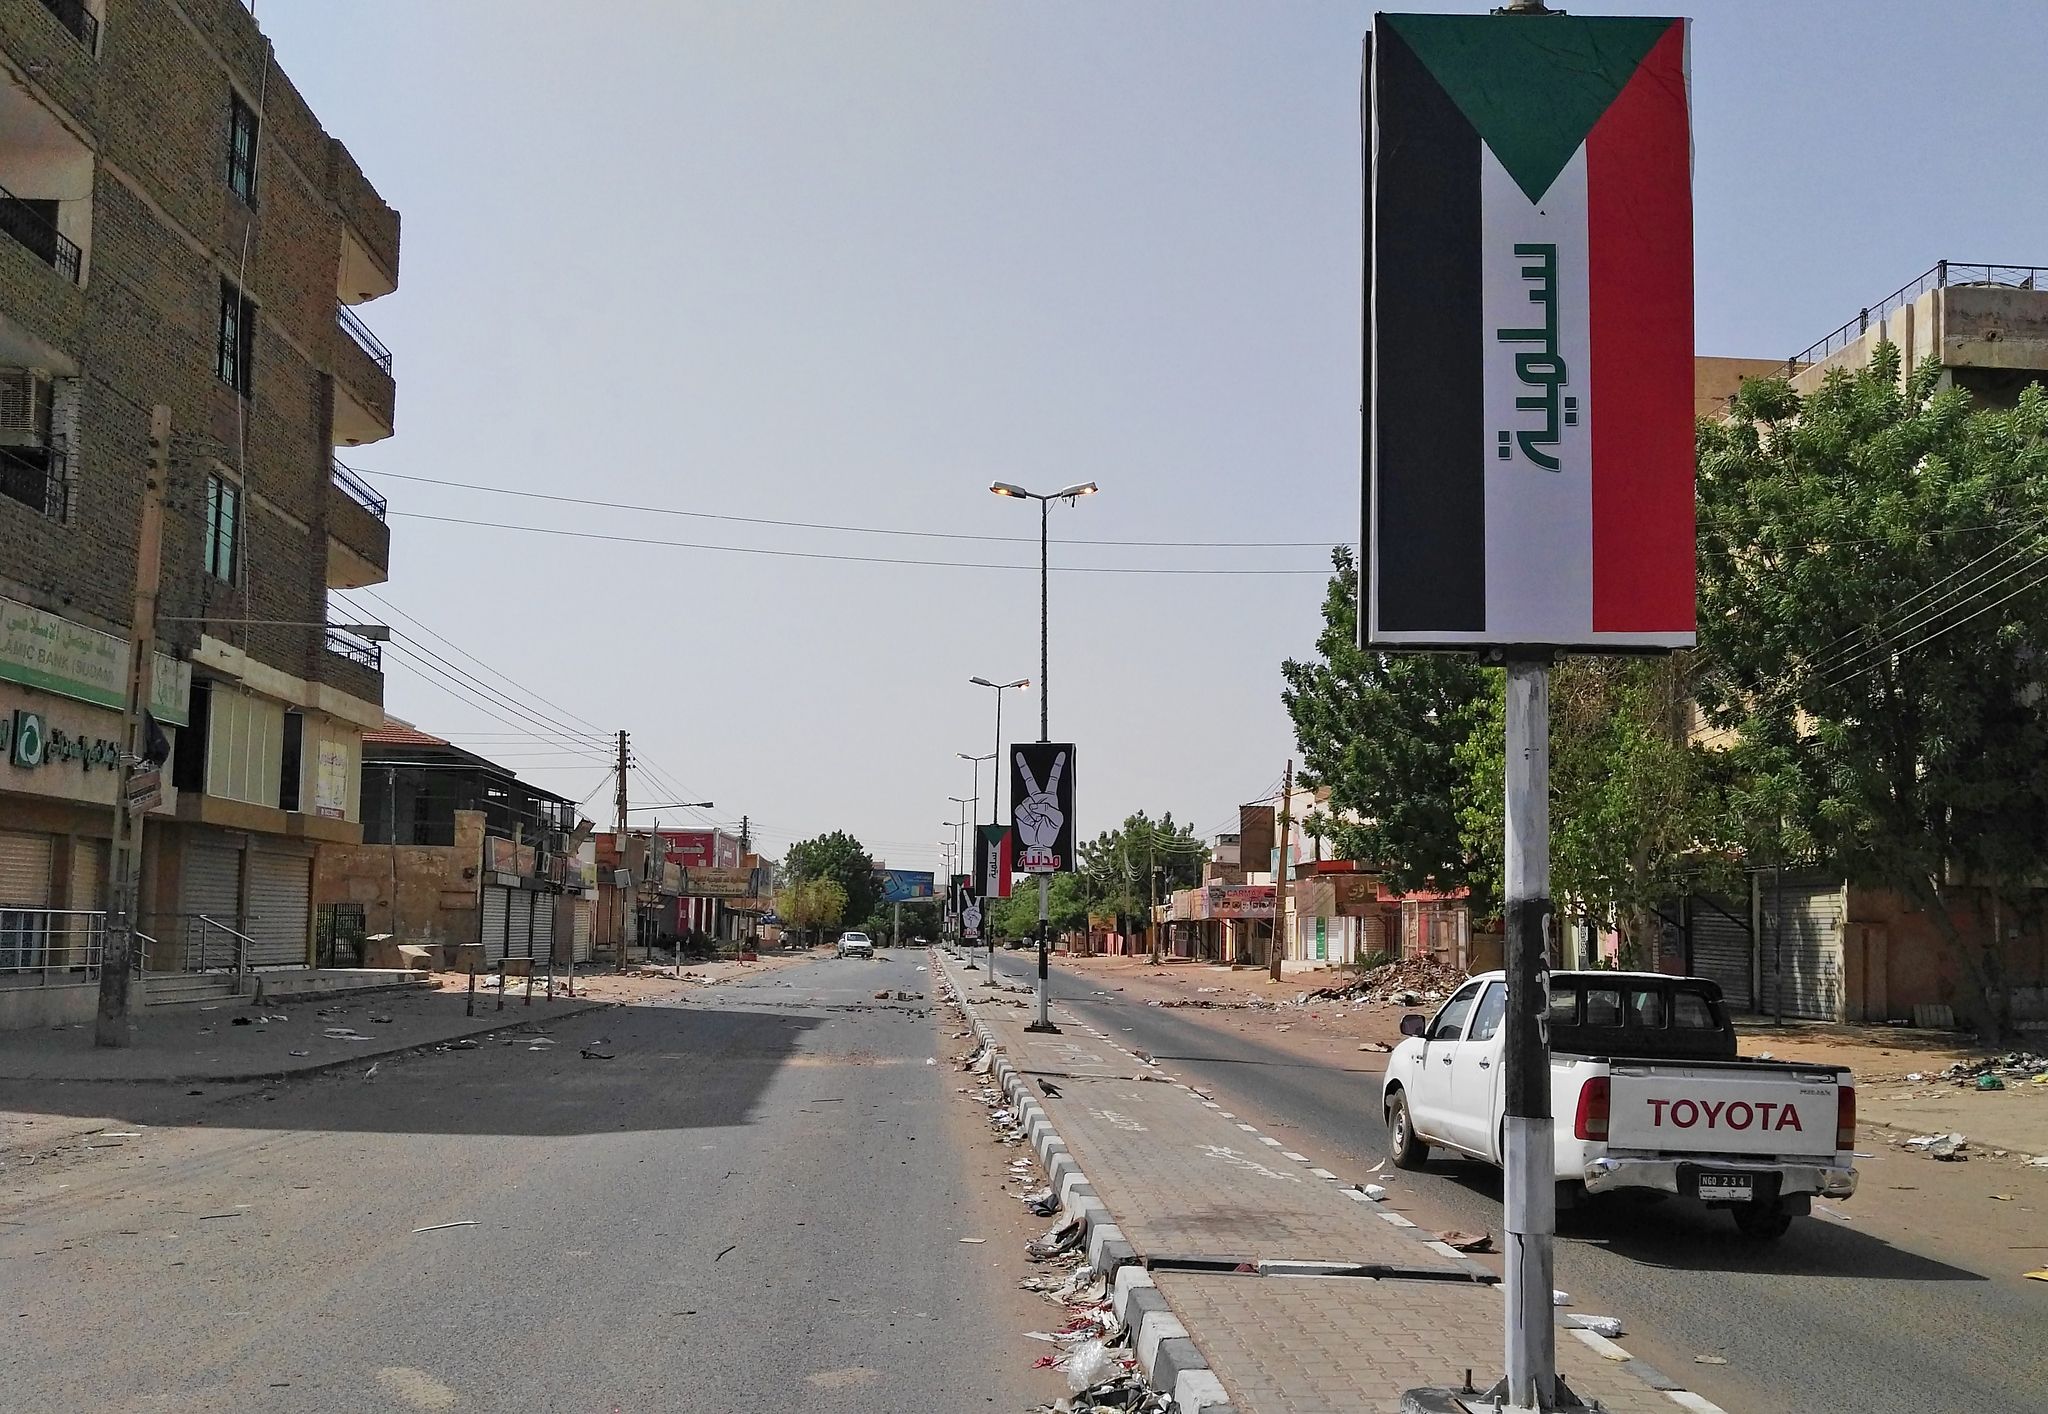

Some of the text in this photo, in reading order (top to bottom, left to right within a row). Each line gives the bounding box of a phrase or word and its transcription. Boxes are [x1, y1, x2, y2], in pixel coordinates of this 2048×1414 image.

[1497, 243, 1578, 470] سلمية
[38, 647, 70, 671] BANK
[1017, 850, 1061, 869] مدنية
[1647, 1099, 1803, 1131] TOYOTA
